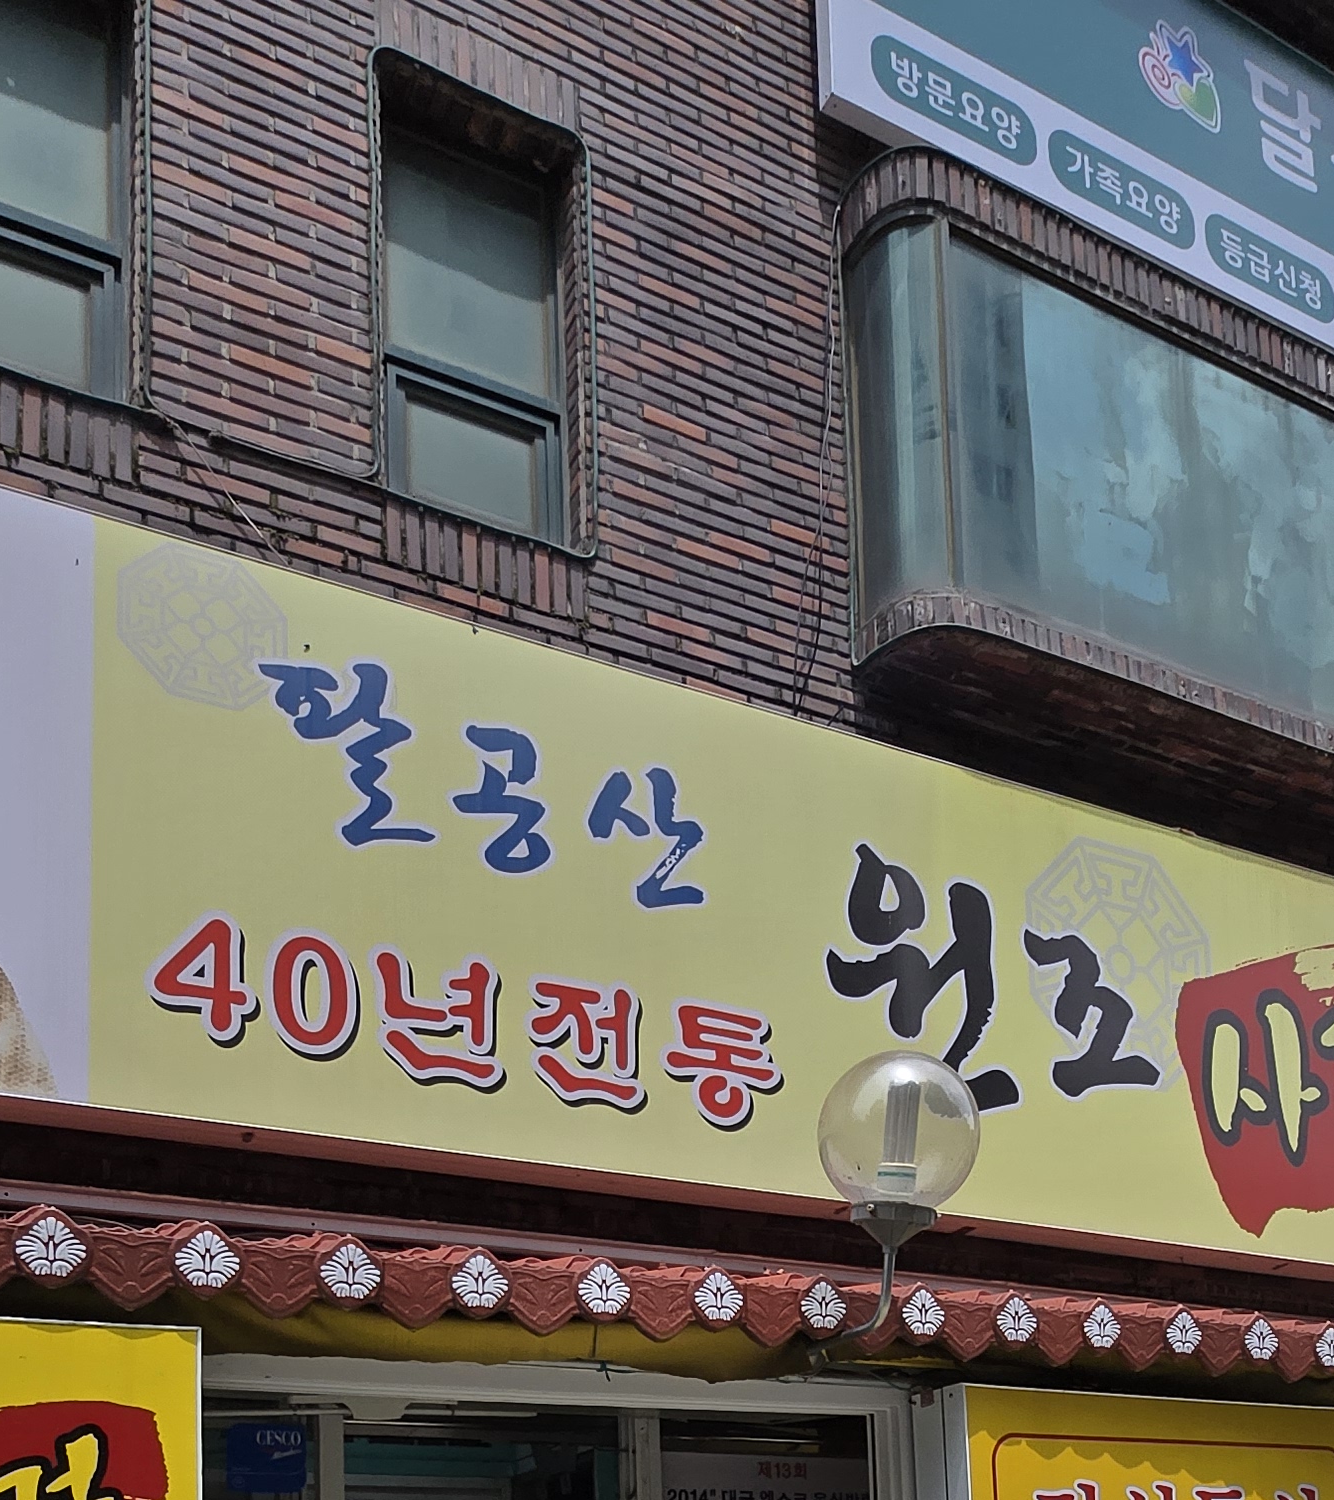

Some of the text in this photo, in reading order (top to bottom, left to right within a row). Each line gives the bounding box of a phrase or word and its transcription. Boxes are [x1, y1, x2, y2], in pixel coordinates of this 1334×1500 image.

[890, 50, 1021, 150] 방문요양
[1065, 144, 1181, 236] 가족요양
[1220, 228, 1322, 311] 등급신청
[258, 661, 706, 910] 팔공산
[826, 843, 1161, 1111] 원조
[256, 1430, 302, 1447] CESCO
